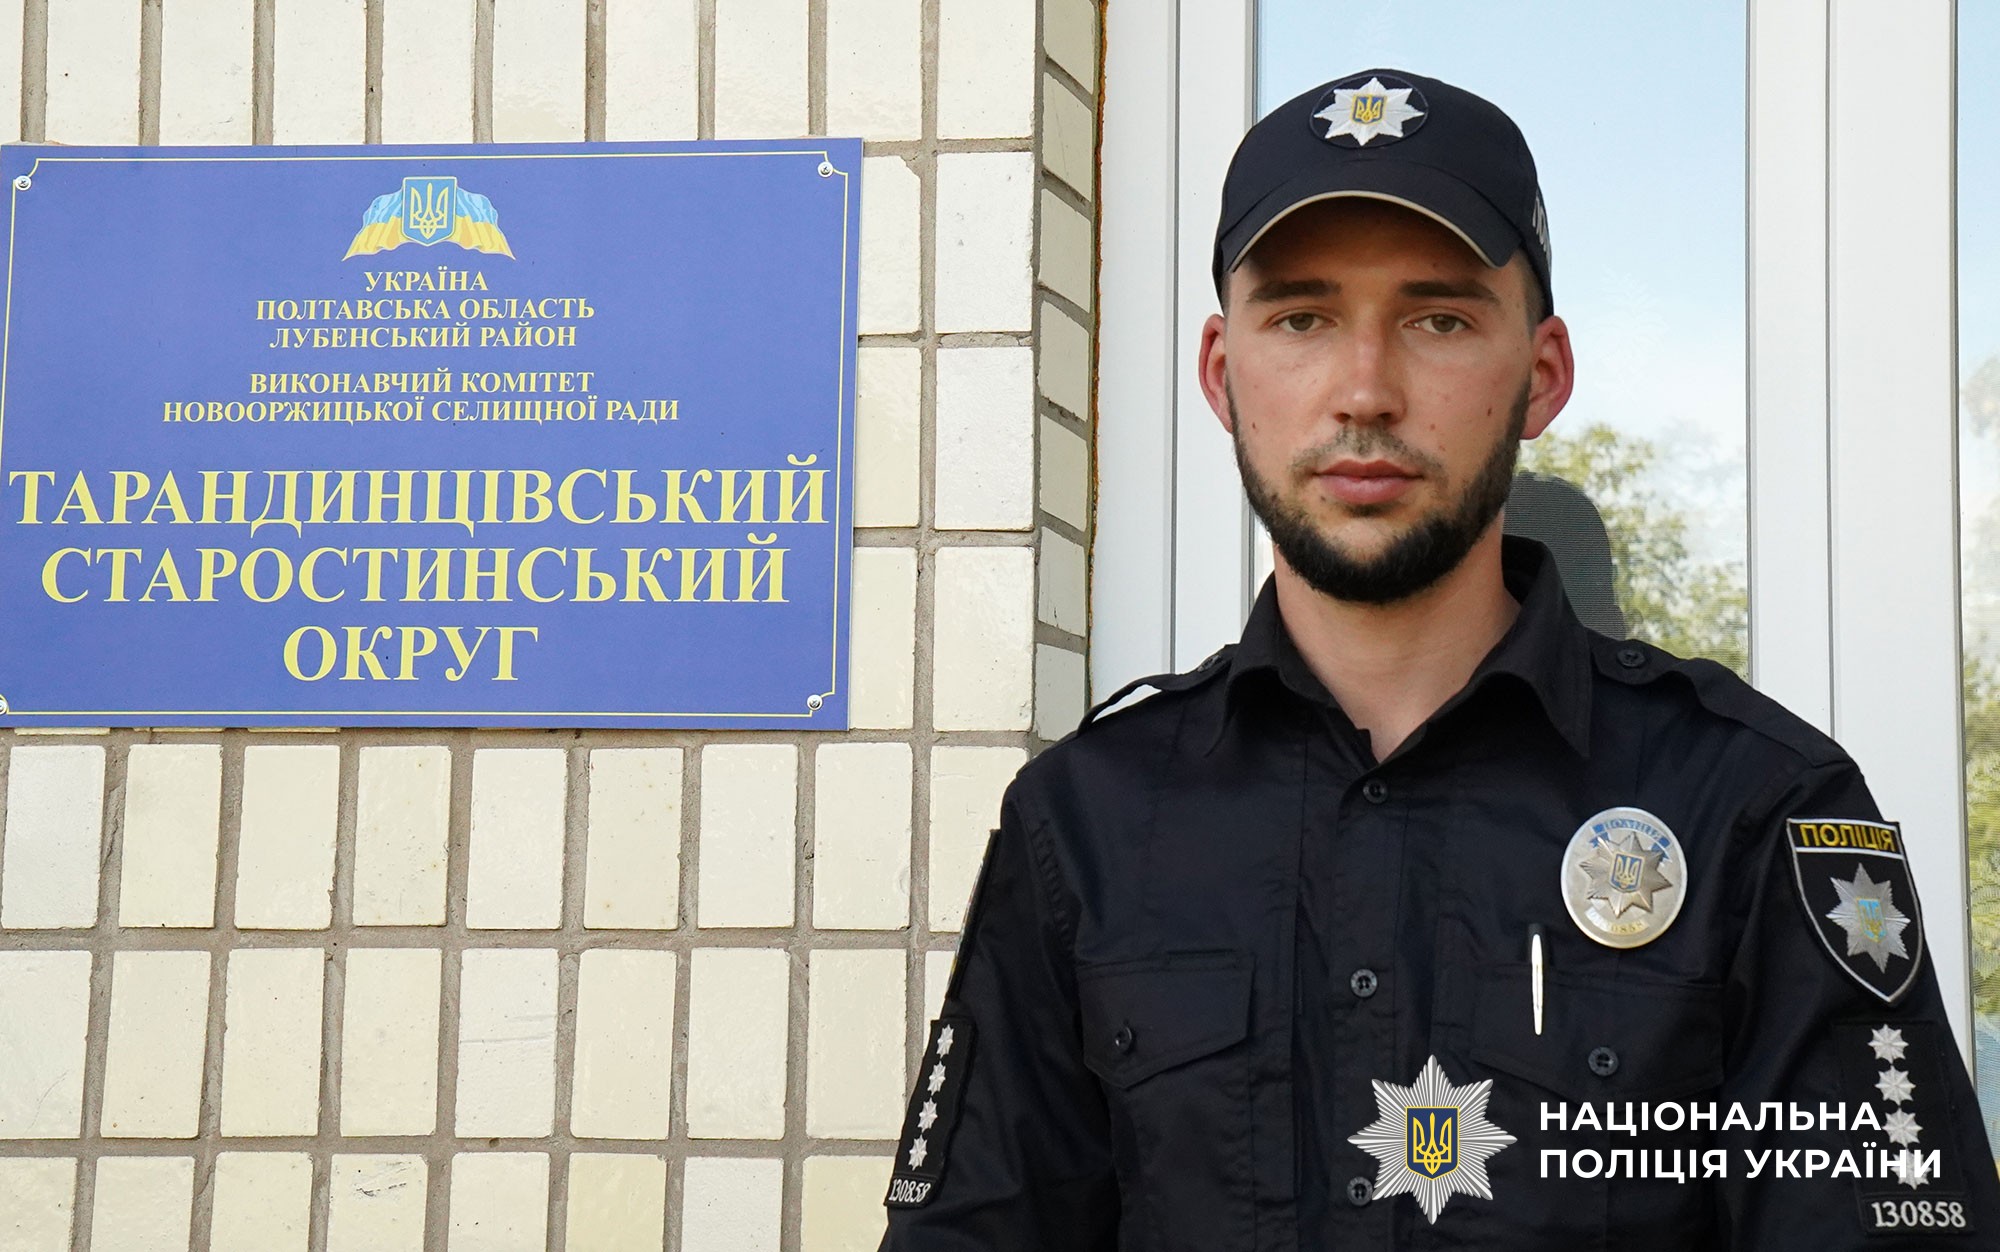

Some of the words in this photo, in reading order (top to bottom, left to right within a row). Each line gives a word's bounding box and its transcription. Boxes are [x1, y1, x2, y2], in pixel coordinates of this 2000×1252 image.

[365, 267, 488, 291] УКРАЇНА
[256, 299, 450, 321] ПОЛТАВСЬКА
[459, 298, 594, 319] ОБЛАСТЬ
[269, 322, 471, 348] ЛУБЕНСЬКИЙ
[480, 322, 576, 347] РАЙОН
[250, 368, 452, 394] ВИКОНАВЧИЙ
[461, 371, 594, 393] КОМІТЕТ
[163, 397, 425, 424] НОВООРЖИЦЬКОЇ
[431, 397, 597, 424] СЕЛИЩНОЇ
[606, 400, 679, 423] РАДИ
[9, 454, 829, 538] ТАРАНДИНЦІВСЬКИЙ
[41, 532, 788, 603] СТАРОСТИНСЬКИЙ
[283, 625, 539, 682] ОКРУГ
[1800, 824, 1896, 852] ПОЛІЦІЯ
[888, 1178, 932, 1203] 130858
[1871, 1200, 1967, 1228] 130858
